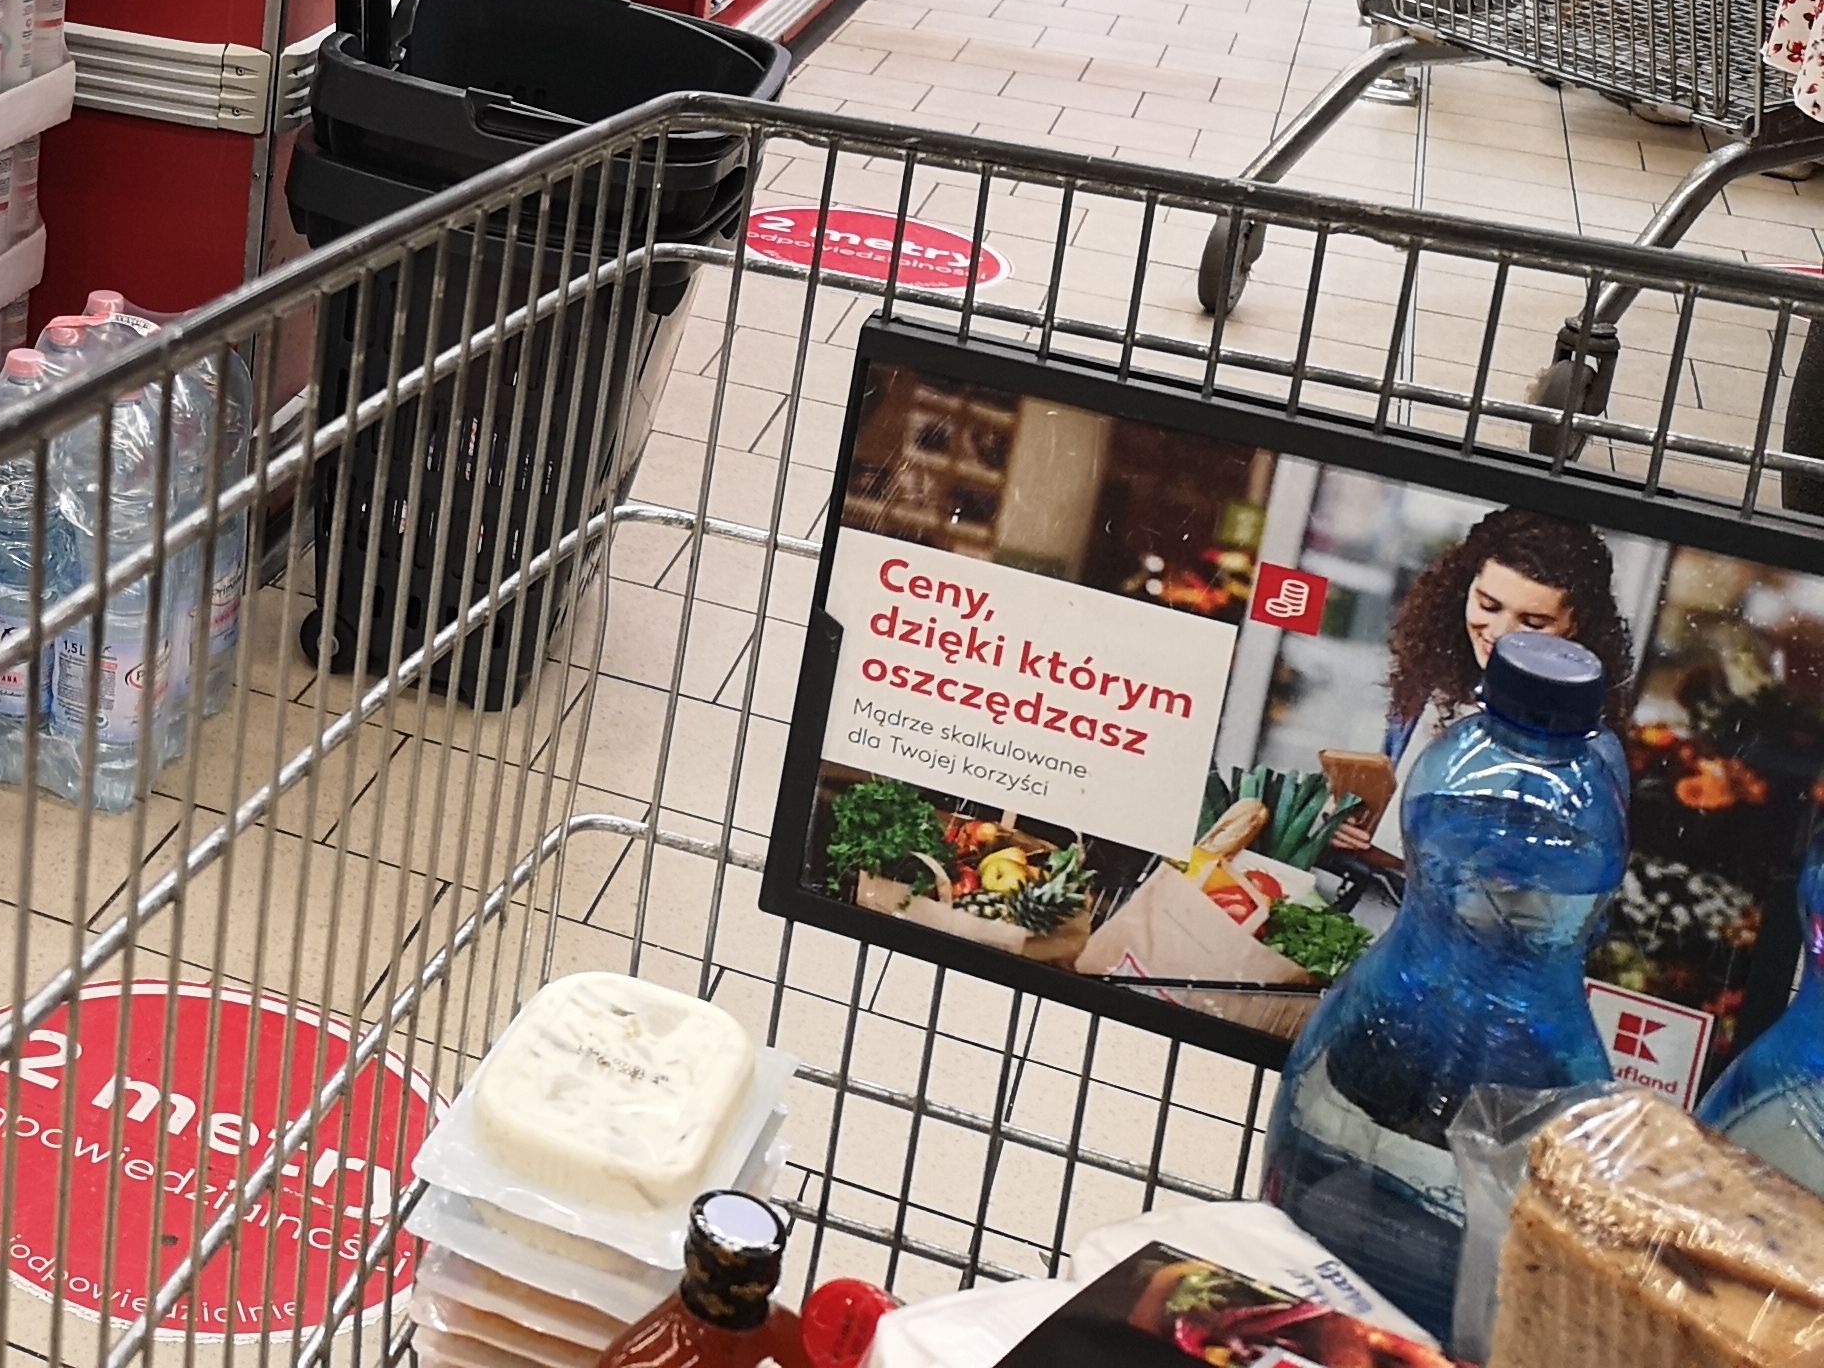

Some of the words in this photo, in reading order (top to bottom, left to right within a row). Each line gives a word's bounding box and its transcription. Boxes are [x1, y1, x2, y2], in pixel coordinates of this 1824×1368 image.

[758, 215, 796, 232] 2
[809, 225, 986, 270] metry
[877, 558, 998, 624] Ceny,
[869, 605, 1007, 669] dzięki
[1017, 634, 1194, 719] którym
[852, 697, 935, 738] Mądrze
[939, 720, 1089, 781] skalkulowane
[860, 653, 1150, 755] oszczędzasz
[847, 726, 882, 751] dla
[888, 733, 957, 775] Twojej
[961, 751, 1050, 799] korzyści
